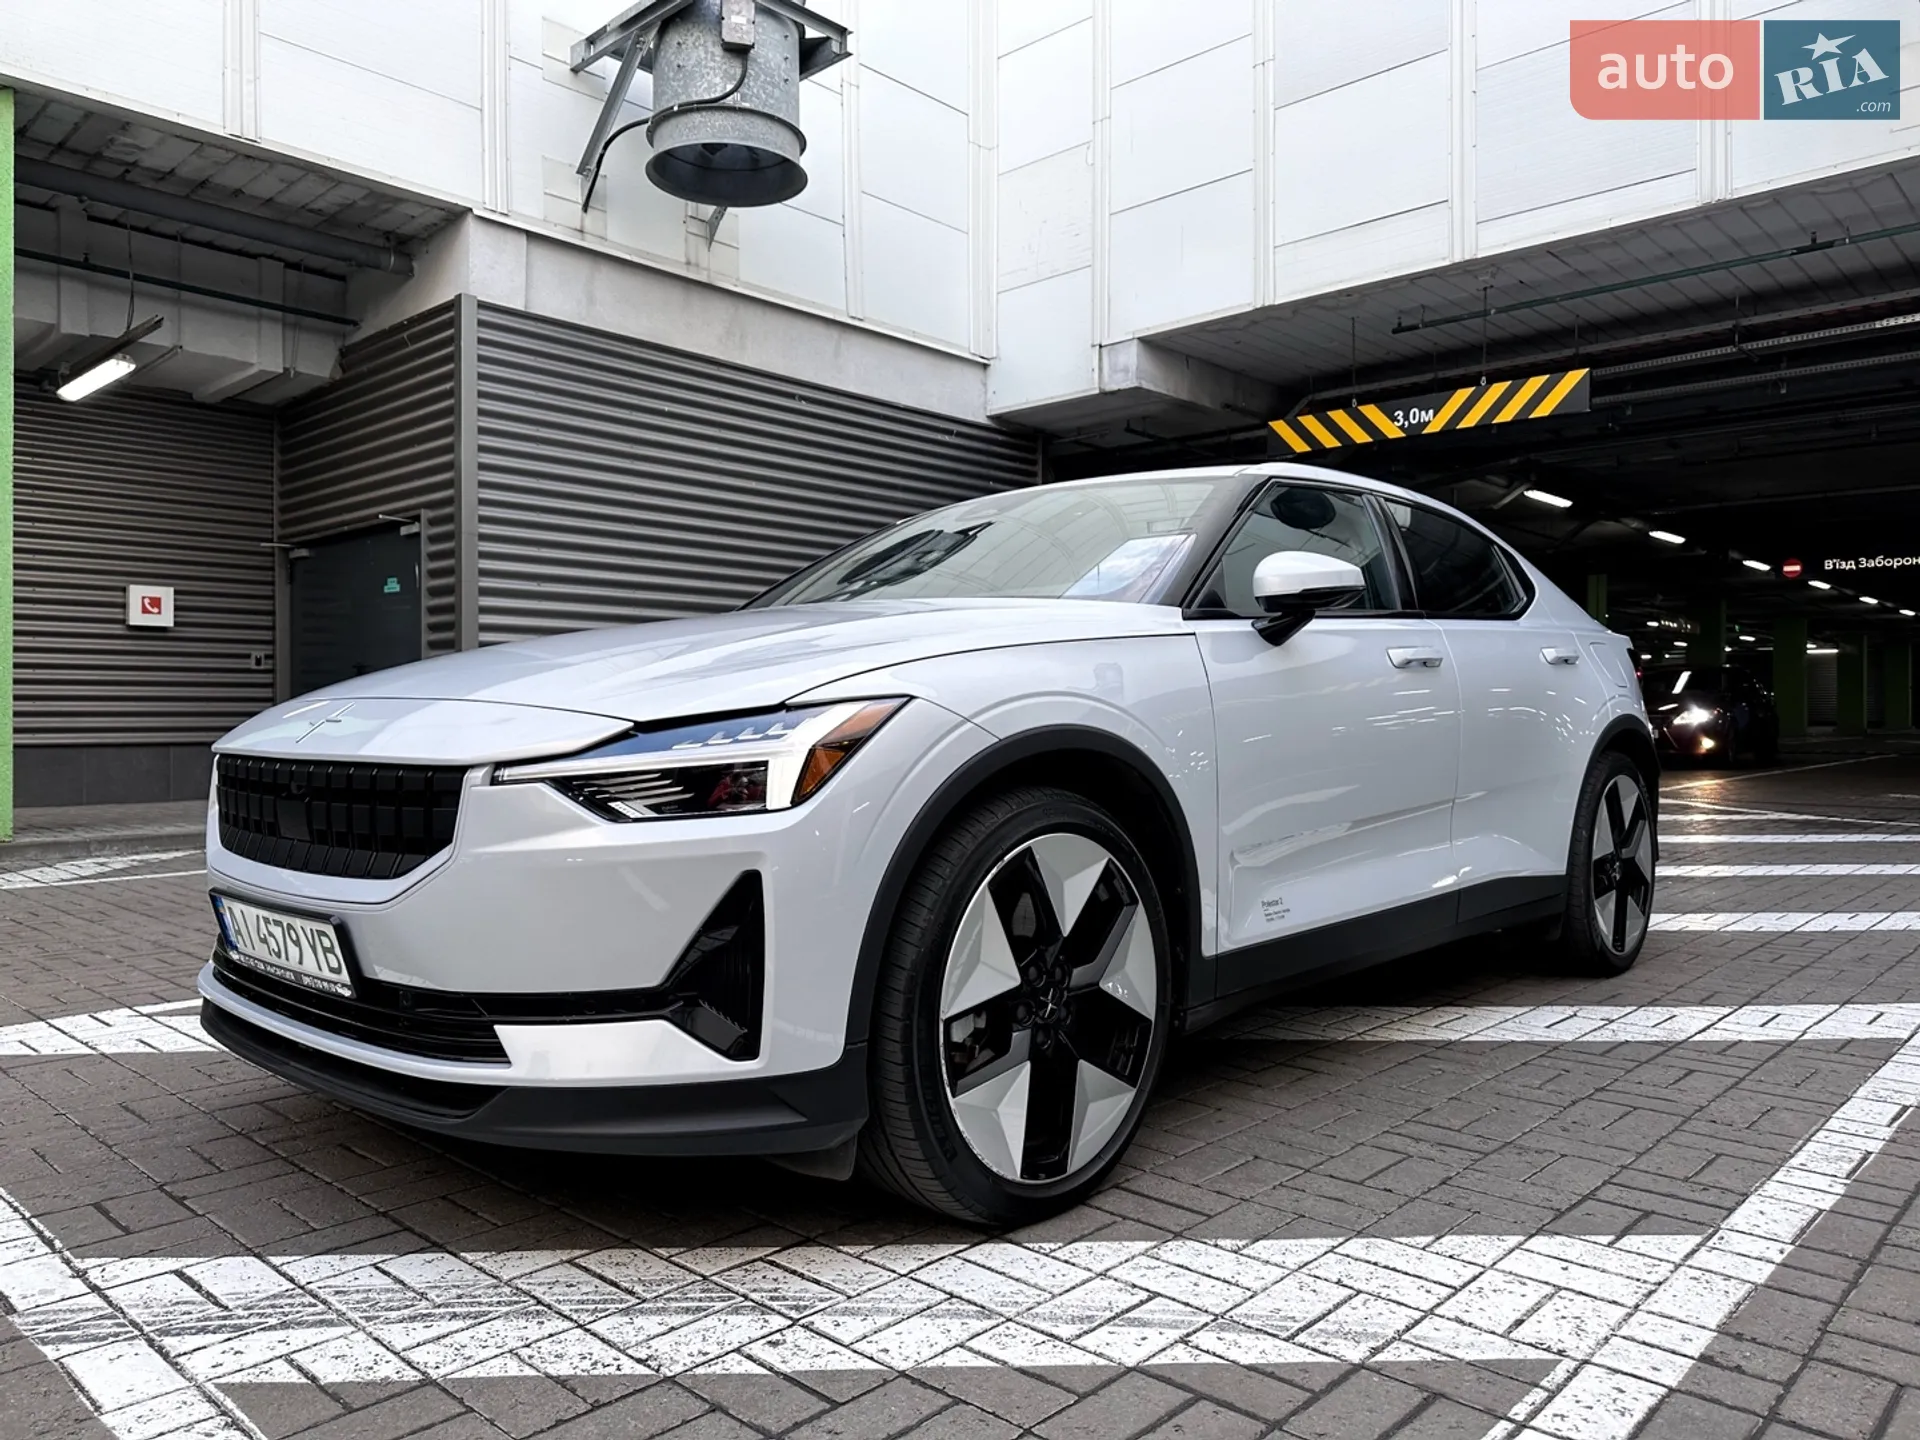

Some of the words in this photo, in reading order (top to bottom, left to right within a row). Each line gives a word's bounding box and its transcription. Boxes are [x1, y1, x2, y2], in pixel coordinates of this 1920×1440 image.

[226, 905, 256, 951] AI
[255, 914, 303, 966] 4579
[300, 925, 343, 975] YB
